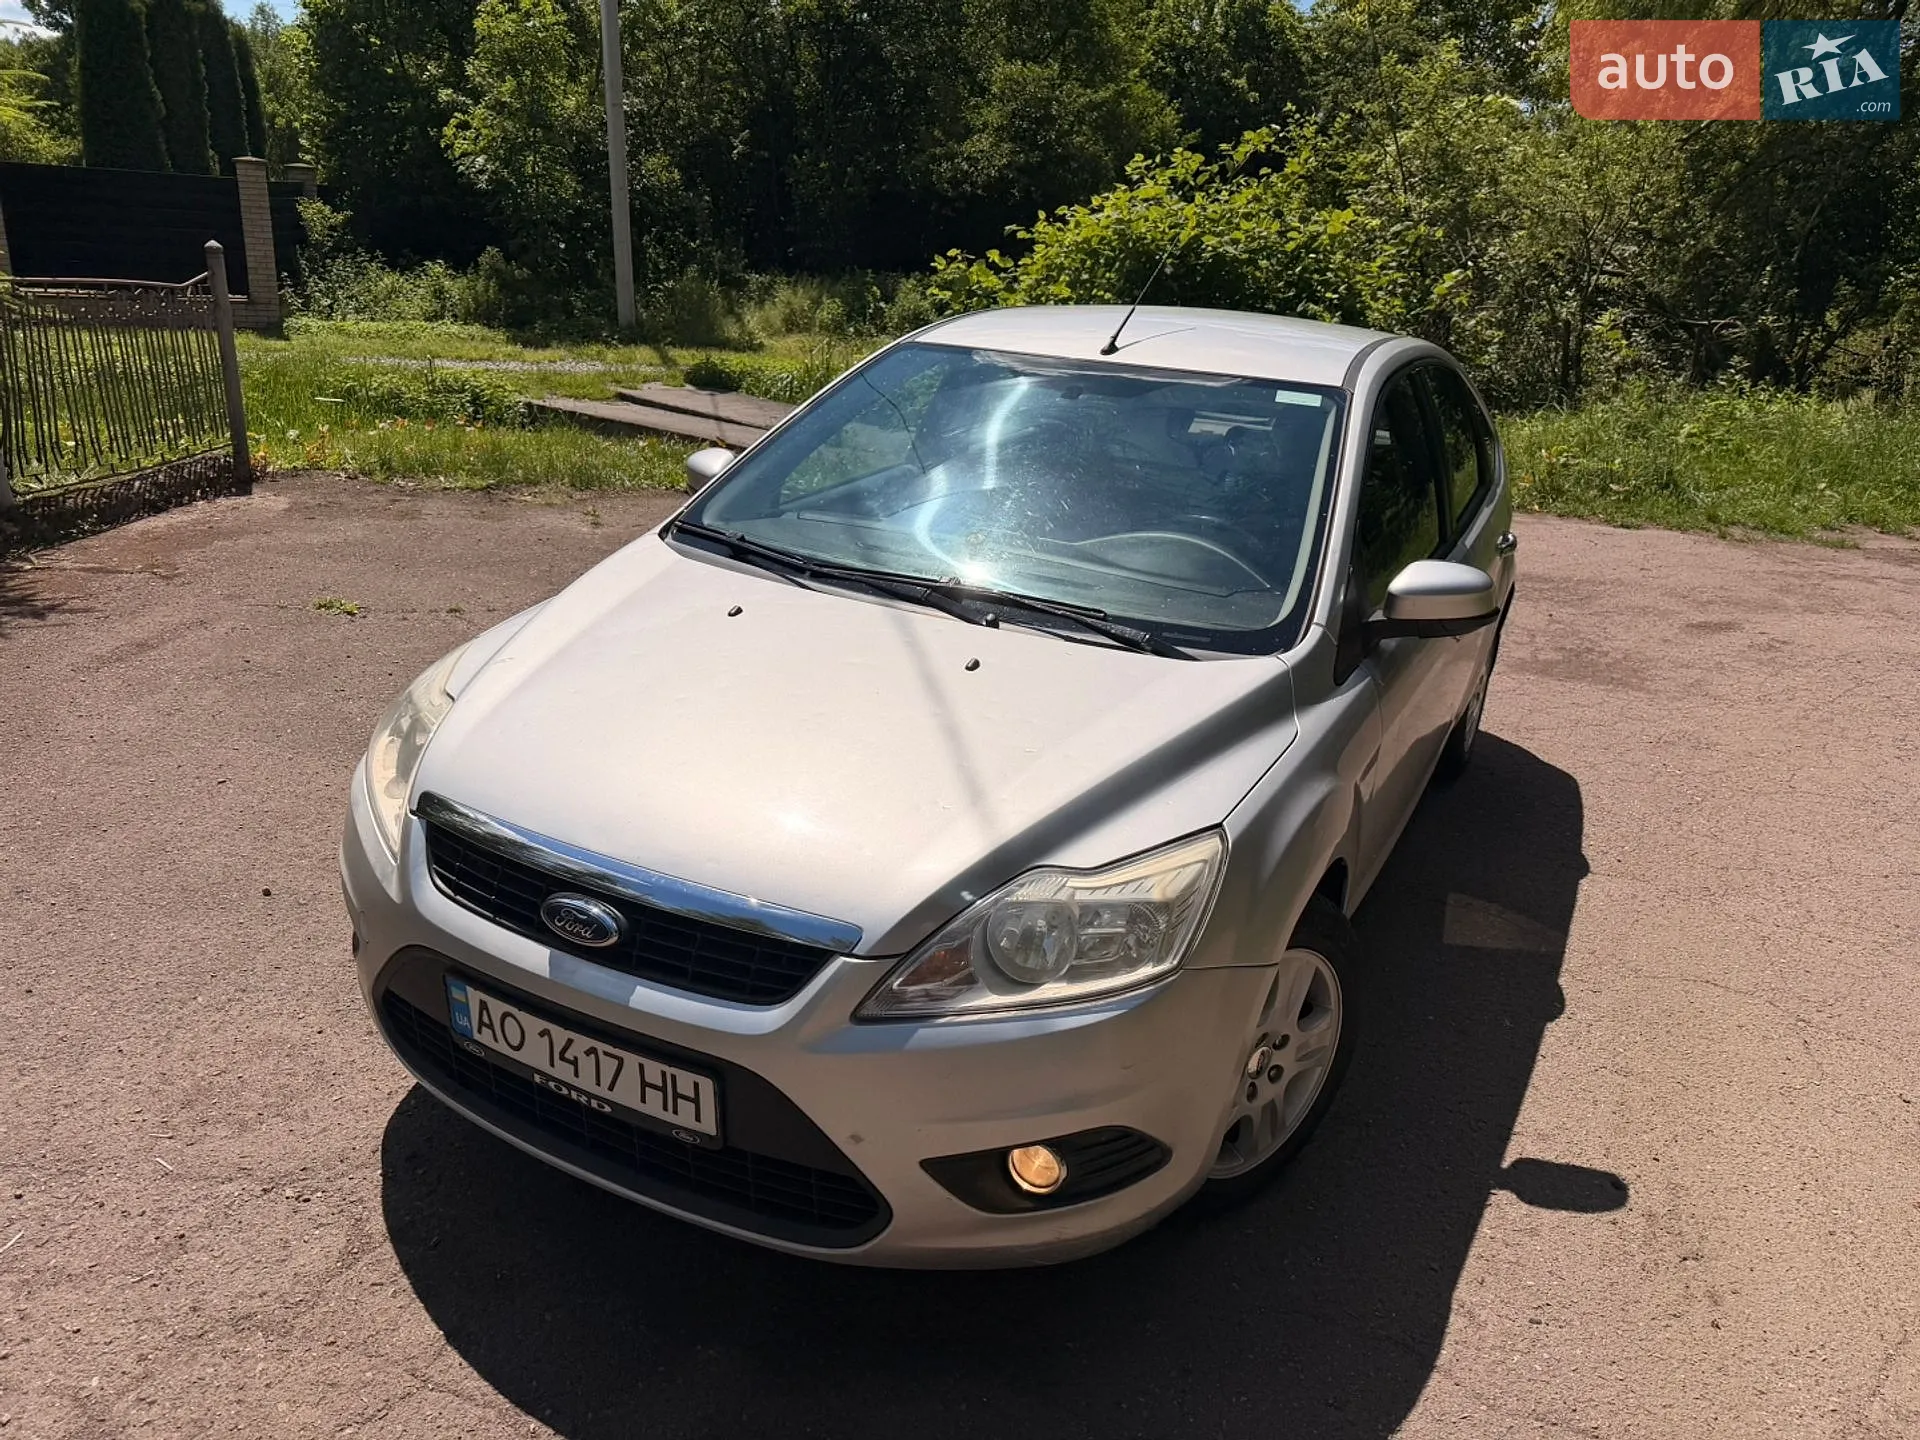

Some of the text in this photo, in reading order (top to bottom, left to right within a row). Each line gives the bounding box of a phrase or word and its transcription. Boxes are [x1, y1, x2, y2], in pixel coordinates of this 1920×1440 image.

[554, 908, 597, 938] Ford
[455, 1011, 470, 1029] UA
[477, 999, 701, 1123] AO 1417 HH
[533, 1073, 612, 1112] FORD
